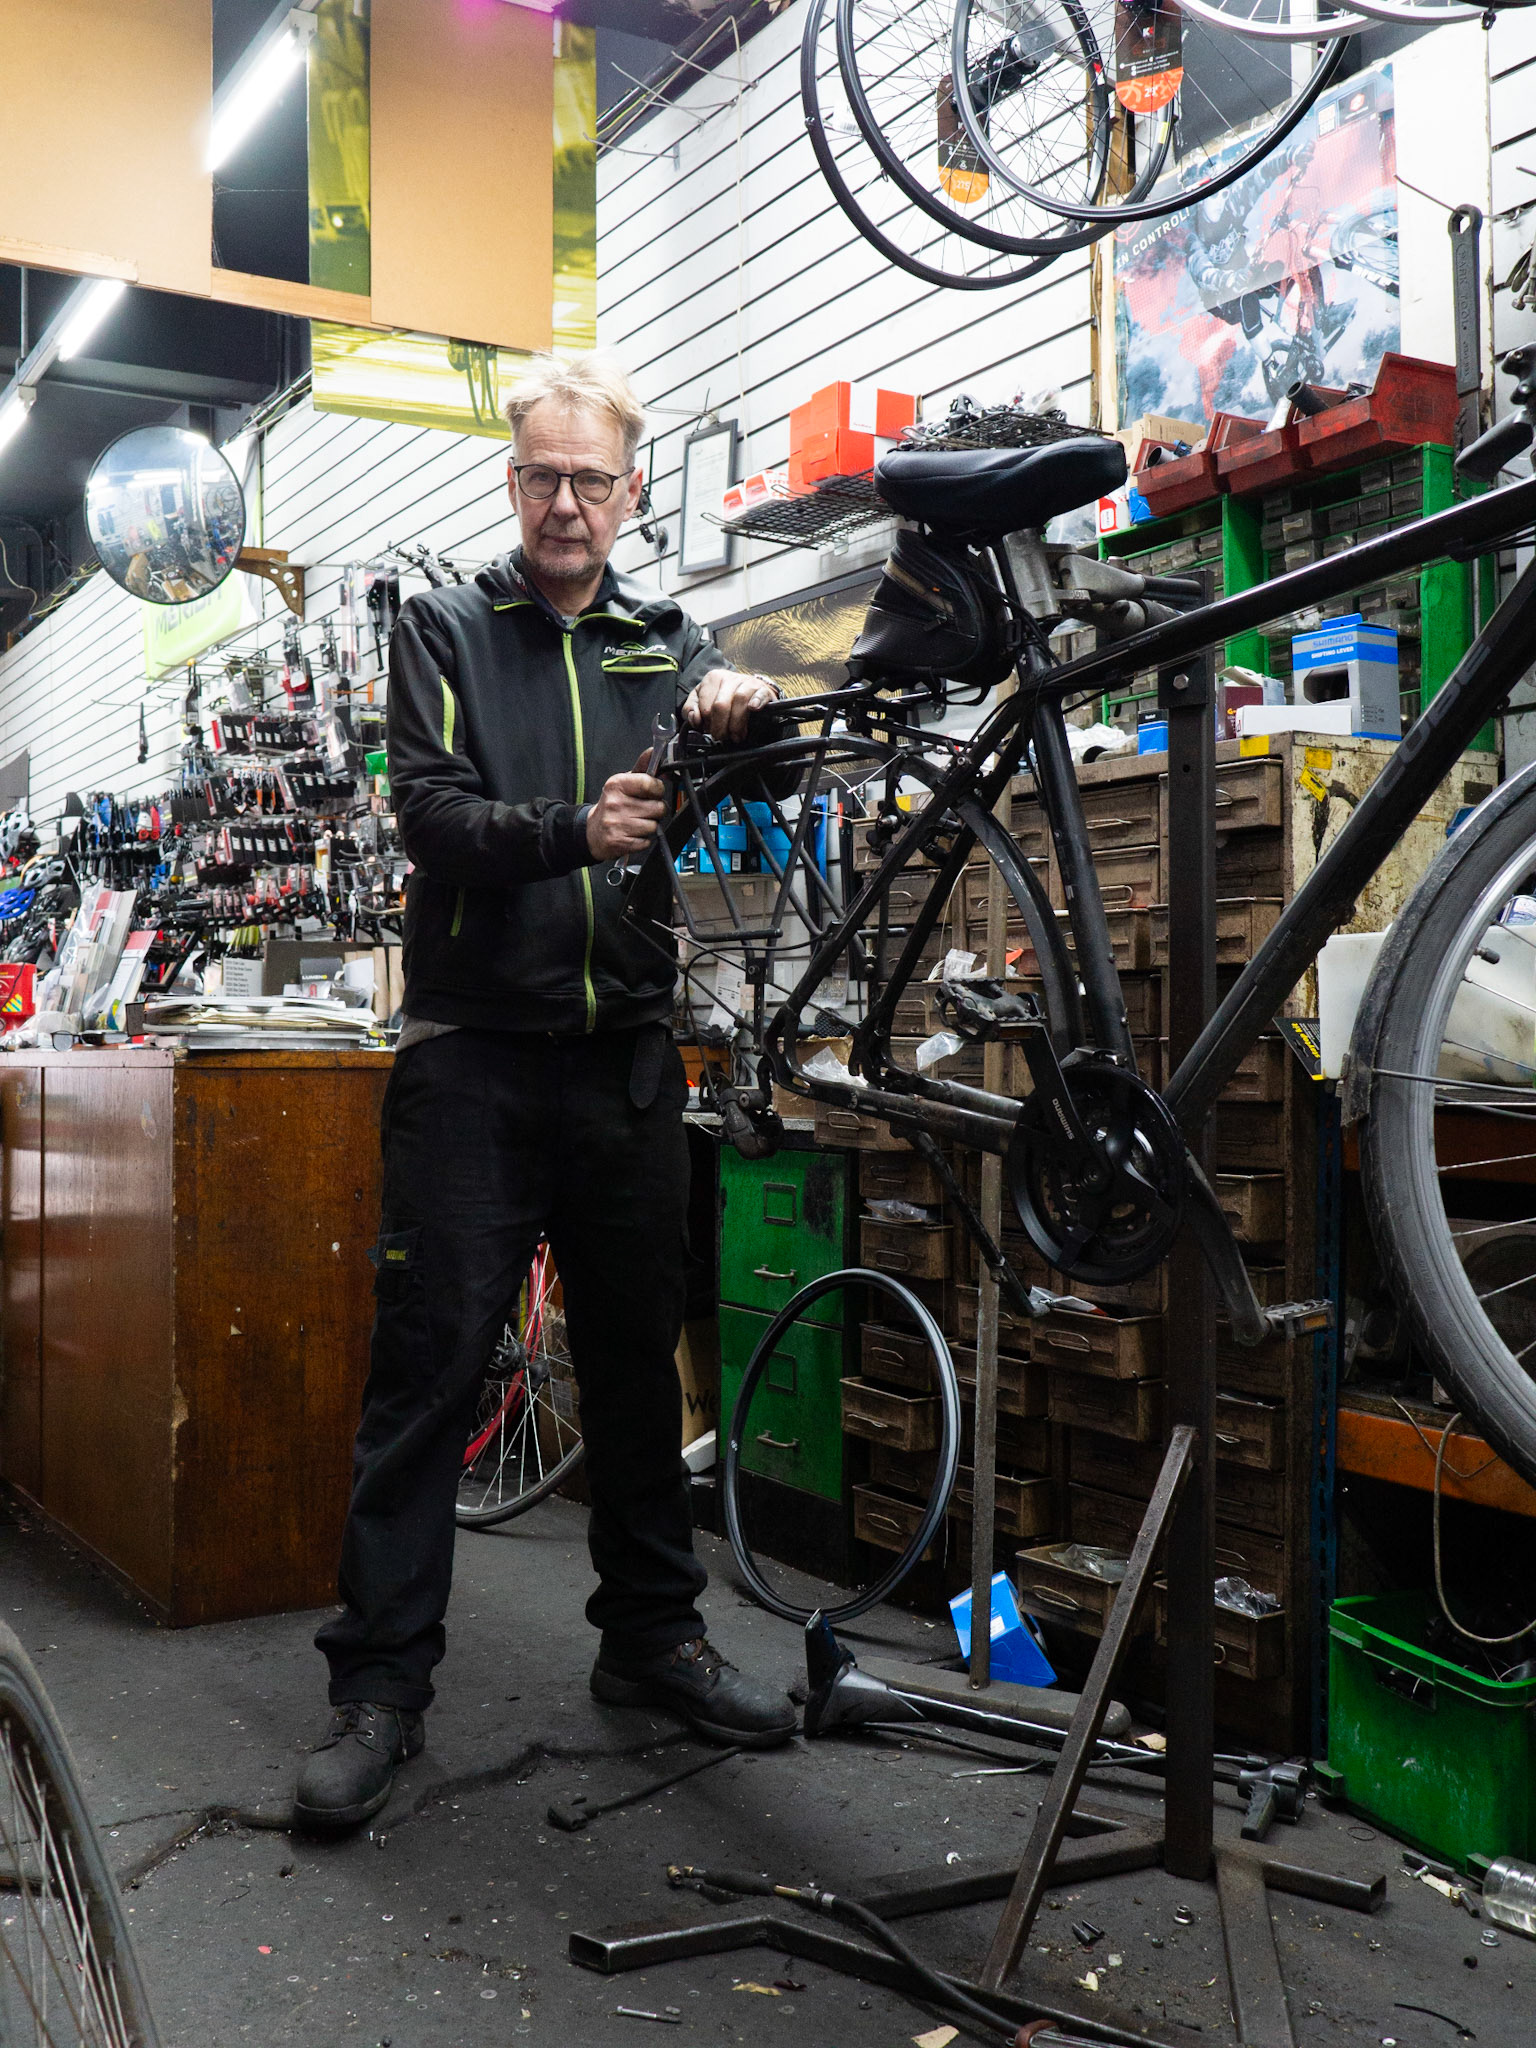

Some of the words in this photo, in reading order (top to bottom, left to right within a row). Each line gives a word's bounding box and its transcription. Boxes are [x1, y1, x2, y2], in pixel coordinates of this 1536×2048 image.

[1115, 254, 1130, 270] IN
[1312, 633, 1354, 648] SHIMANO
[1311, 649, 1336, 659] SHIFTING
[1336, 645, 1354, 654] LEVER
[1374, 642, 1492, 799] CUBE
[1052, 1098, 1075, 1140] SHIMANO
